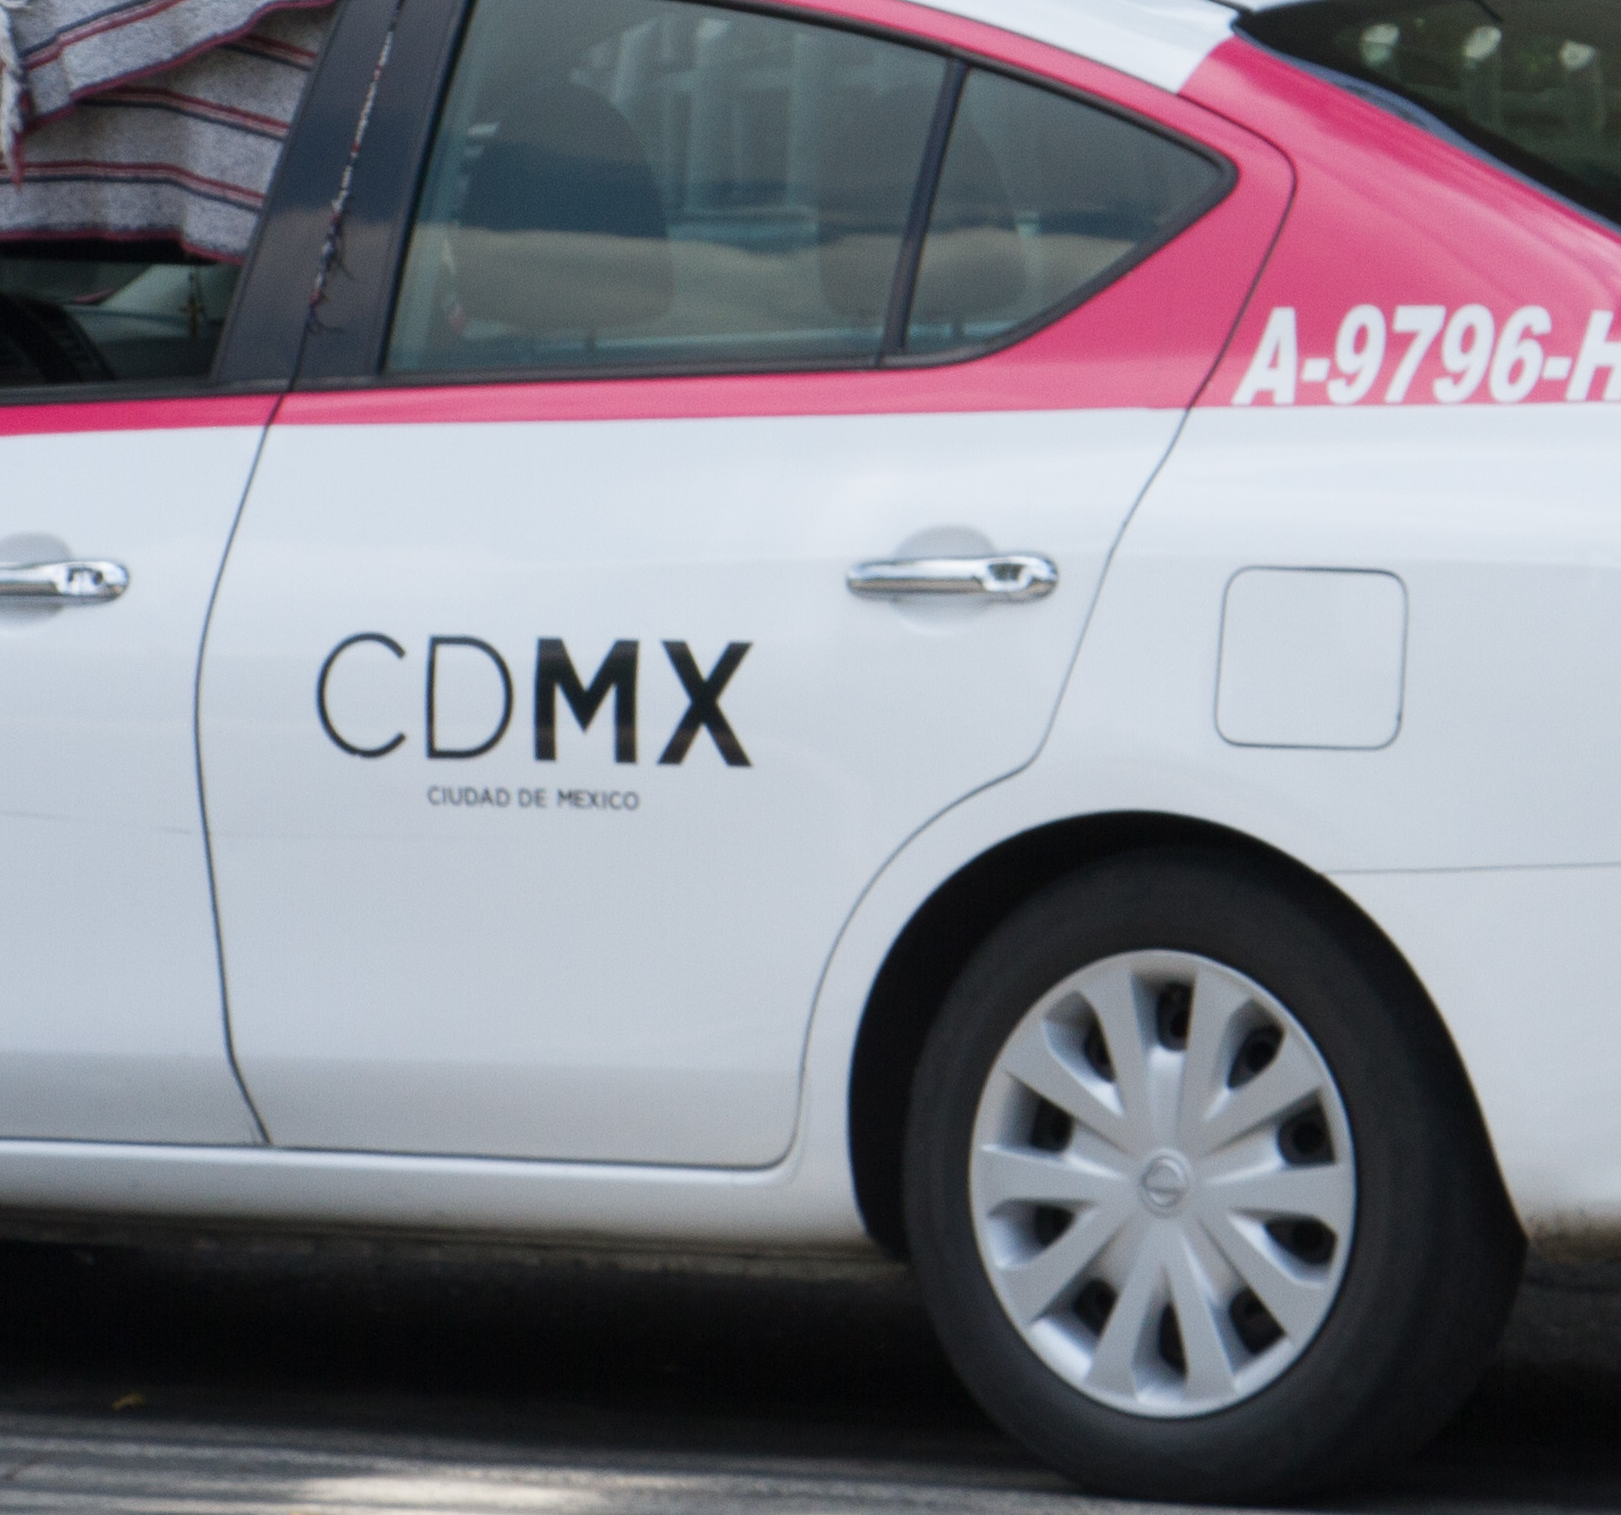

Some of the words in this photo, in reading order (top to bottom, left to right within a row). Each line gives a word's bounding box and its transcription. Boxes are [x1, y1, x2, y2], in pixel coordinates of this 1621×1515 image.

[316, 631, 753, 768] CDMX
[427, 786, 511, 808] CIUDAD
[517, 789, 547, 809] DE
